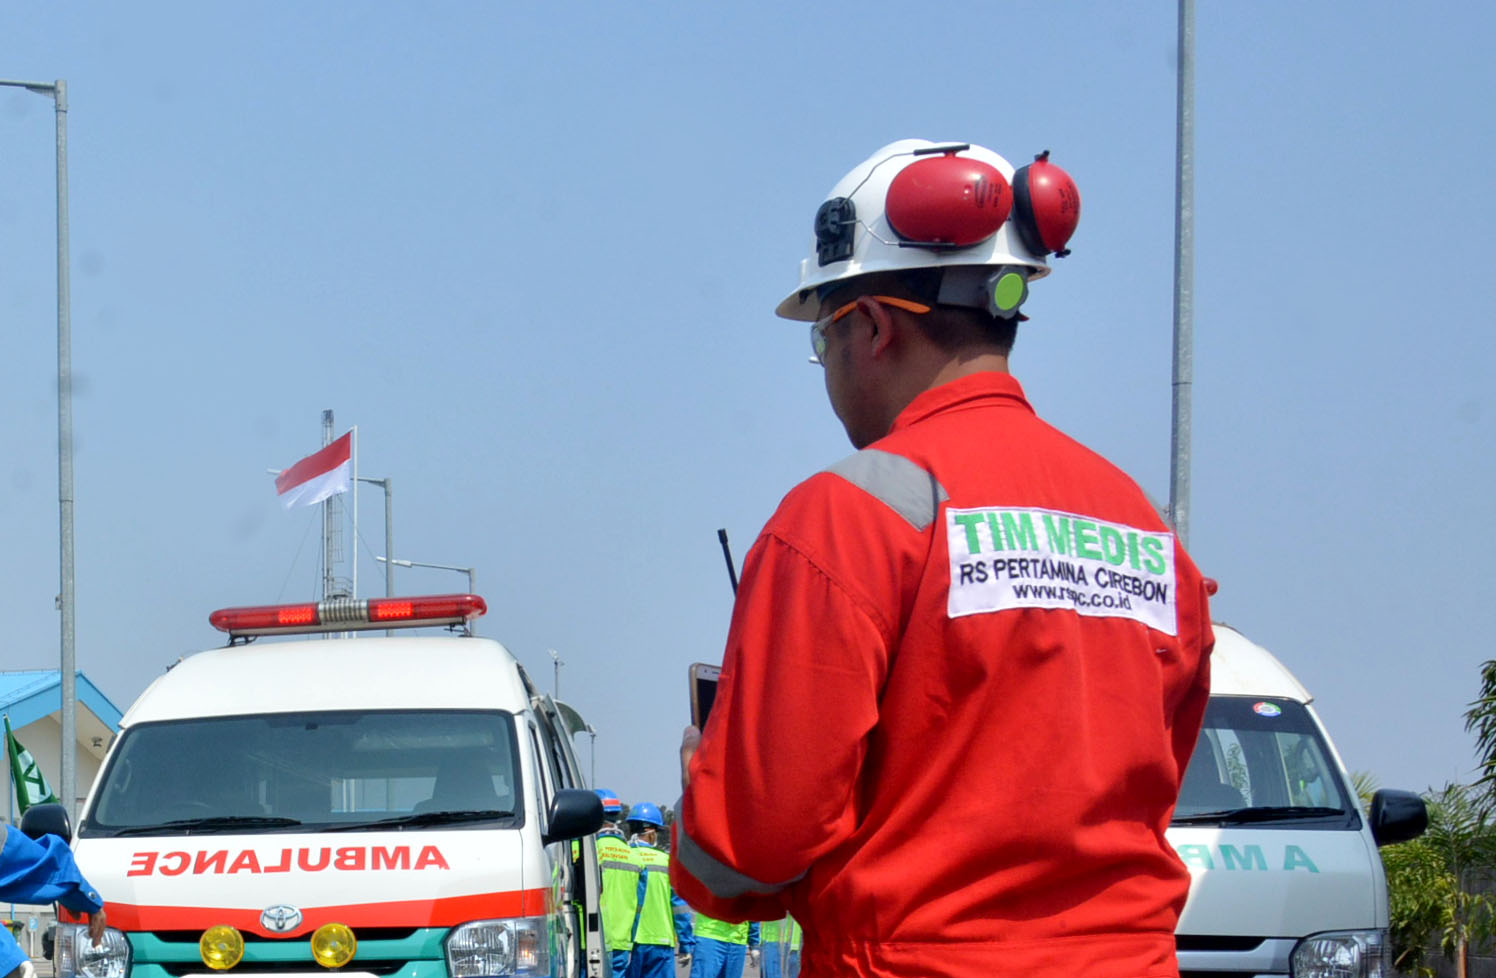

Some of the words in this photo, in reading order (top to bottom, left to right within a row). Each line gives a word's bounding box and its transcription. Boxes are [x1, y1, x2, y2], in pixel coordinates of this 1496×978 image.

[954, 511, 1040, 555] TIM
[1042, 513, 1167, 576] MEDIS
[959, 561, 989, 585] RS
[992, 557, 1089, 586] PERTAMINA
[1094, 567, 1168, 605] CIREBON
